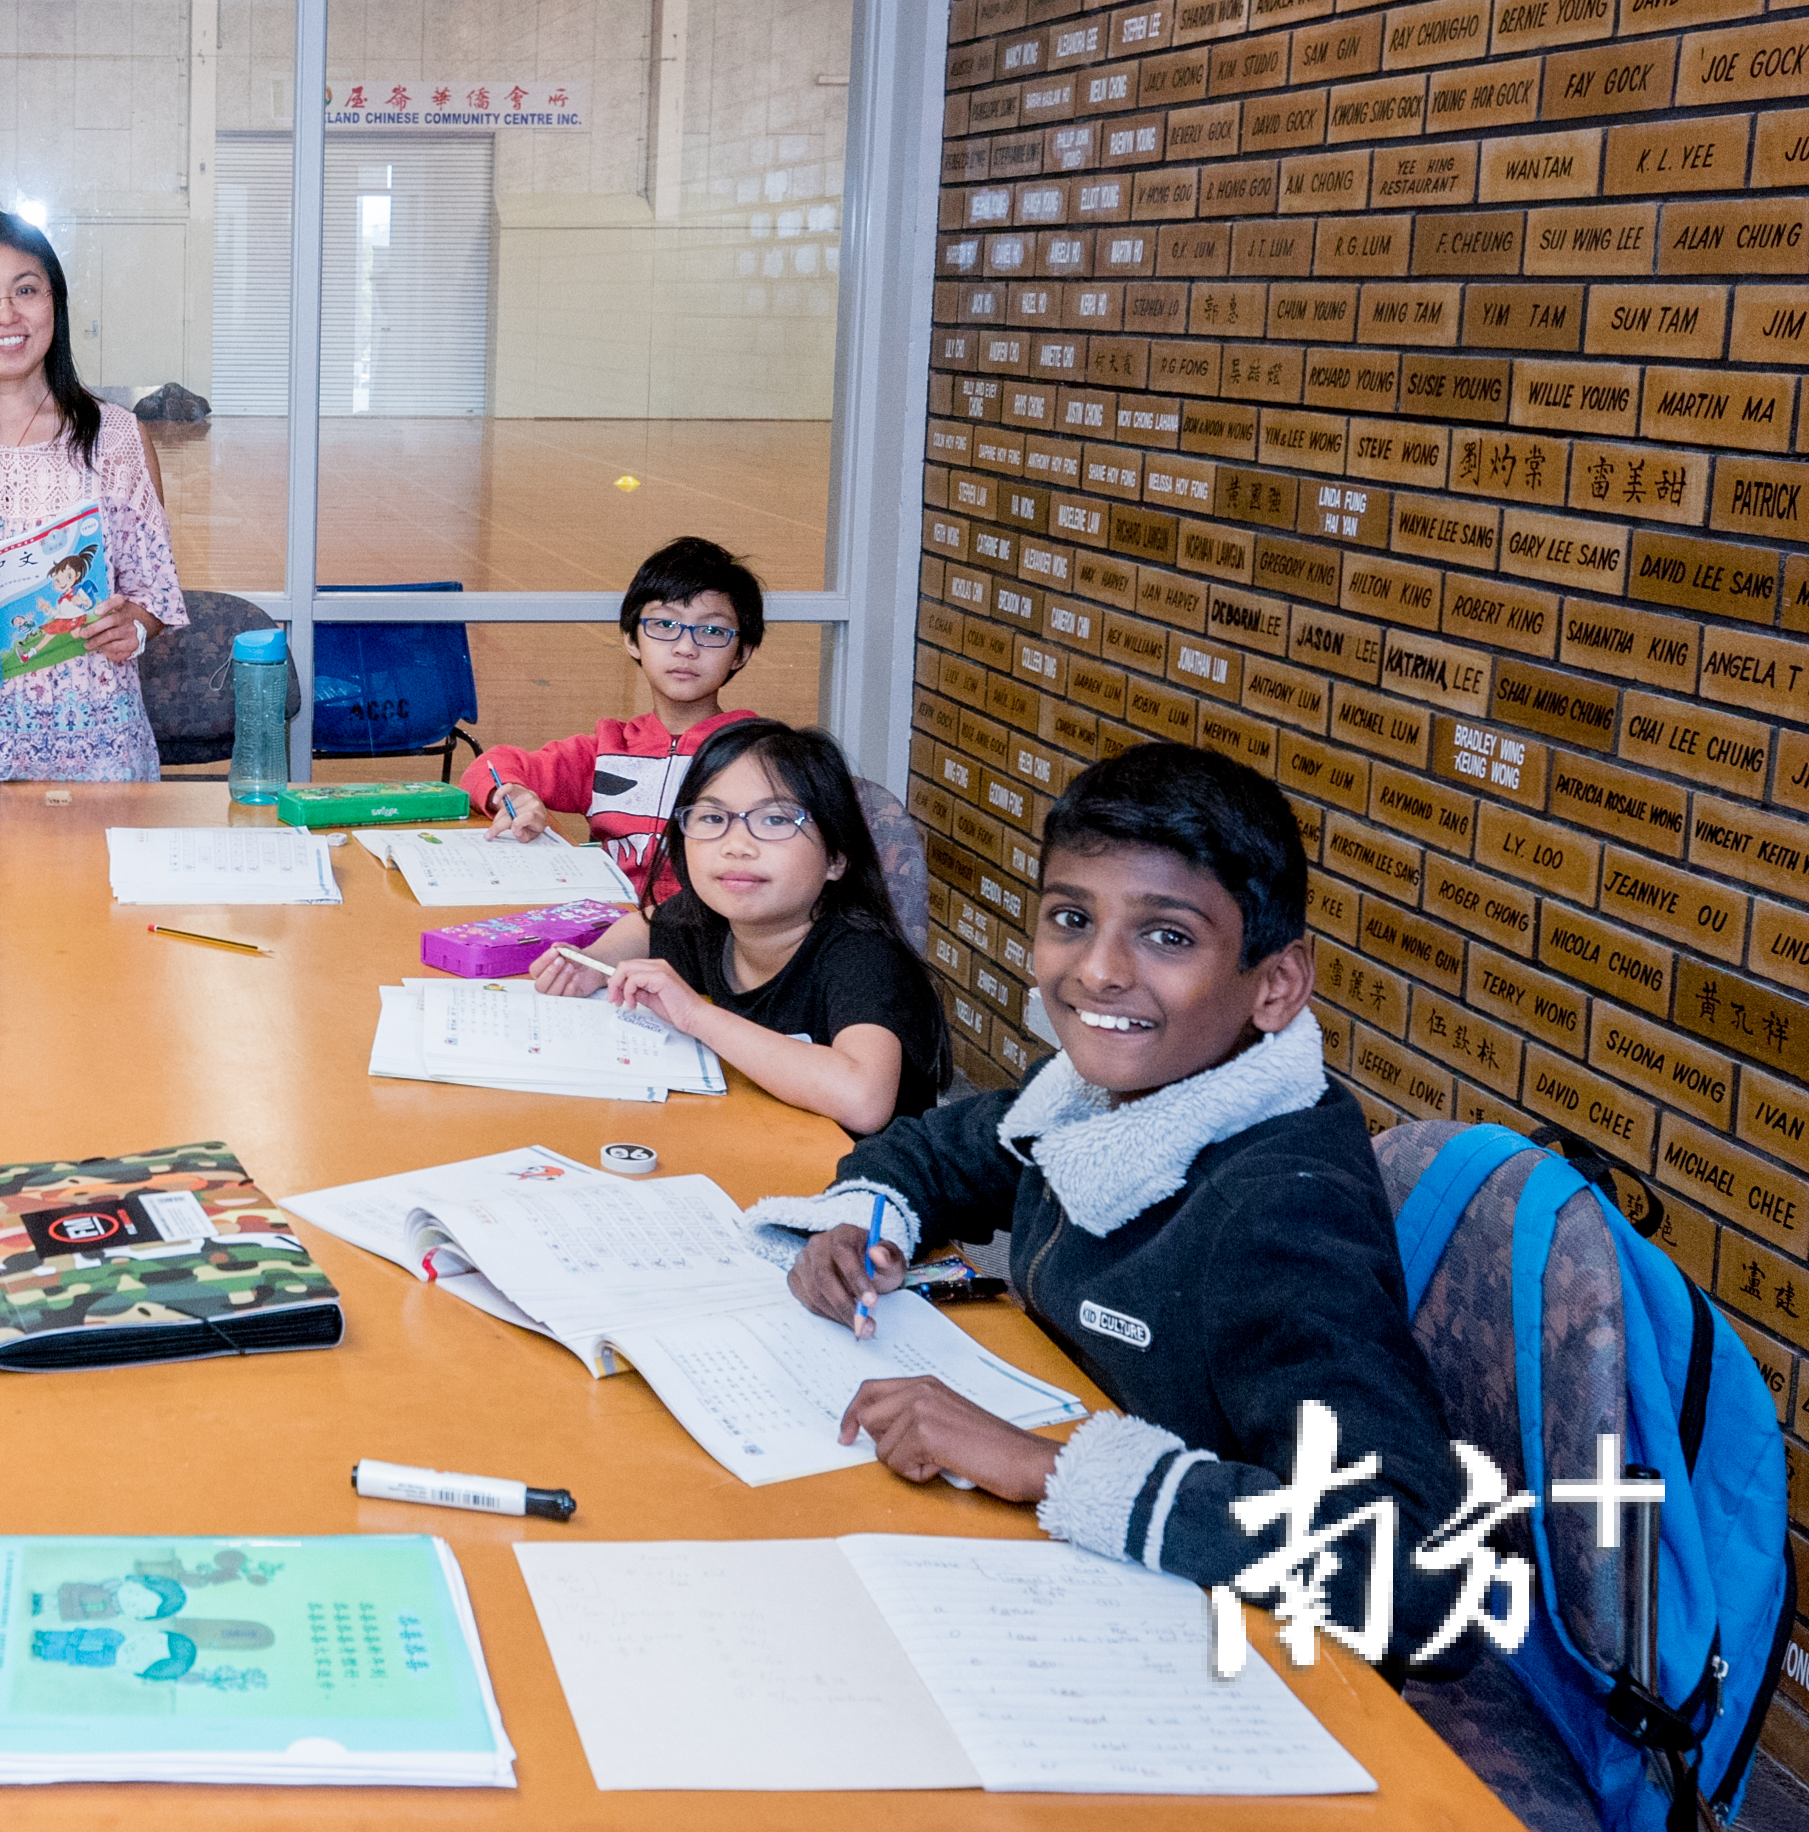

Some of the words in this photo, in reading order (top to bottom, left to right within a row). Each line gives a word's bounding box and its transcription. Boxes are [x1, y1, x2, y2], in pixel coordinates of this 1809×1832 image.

[1498, 2, 1549, 34] BERNIE
[1555, 0, 1608, 22] YOUNG
[1303, 44, 1329, 66] SAM
[1337, 37, 1360, 60] GIN
[1389, 28, 1413, 52] RAY
[1145, 71, 1167, 91] JACK
[1172, 64, 1203, 87] CHONG
[1243, 52, 1278, 76] STUDIO
[1565, 72, 1596, 99] FAY
[1604, 63, 1655, 94] GOCK
[365, 112, 419, 124] CHINESE
[424, 112, 500, 124] COMMUNITY
[504, 113, 553, 125] CENTRE
[557, 113, 582, 126] INC.
[1252, 116, 1281, 136] DAVID
[1287, 108, 1318, 132] GOCK
[1331, 102, 1368, 126] KWONG
[1370, 100, 1395, 123] SING
[1397, 94, 1424, 119] GOCK
[1208, 120, 1234, 140] GOCK
[1379, 175, 1459, 196] RESTAURANT
[1540, 229, 1567, 250] SUI
[1573, 228, 1611, 251] WING
[1617, 226, 1644, 250] LEE
[1673, 225, 1725, 250] ALAN
[1737, 222, 1802, 249] CHUNG
[1277, 300, 1307, 320] CHUM
[1313, 300, 1346, 320] YOUNG
[1373, 301, 1407, 323] MING
[1413, 302, 1444, 324] TAM
[1483, 303, 1511, 326] YIM
[1529, 304, 1567, 328] TAM
[1611, 307, 1652, 332] SUN
[1657, 307, 1699, 334] TAM
[1762, 310, 1807, 340] JIM
[1309, 366, 1351, 388] RICHARD
[1355, 369, 1395, 393] YOUNG
[1407, 373, 1445, 398] SUSIE
[1452, 376, 1502, 402] YOUNG
[1528, 381, 1574, 410] WILLIE
[1579, 385, 1630, 412] YOUNG
[1657, 391, 1729, 419] MARTIN
[1741, 397, 1775, 422] MA
[1357, 437, 1393, 460] STEVE
[1401, 442, 1439, 466] WONG
[1319, 486, 1341, 508] LINDA
[1731, 480, 1802, 520] PATRICK
[1325, 514, 1339, 532] HAI
[1343, 516, 1359, 537] YAN
[1398, 511, 1436, 540] WAYNE
[1437, 519, 1458, 542] LEE
[1459, 524, 1494, 549] SANG
[1259, 551, 1306, 578] GREGORY
[1307, 562, 1335, 586] KING
[1509, 532, 1544, 558] GARY
[1547, 538, 1574, 563] LEE
[1577, 544, 1620, 572] SANG
[1349, 572, 1392, 598] HILTON
[1399, 580, 1432, 608] KING
[1639, 555, 1687, 584] DAVID
[1693, 564, 1725, 592] LEE
[1729, 571, 1775, 599] SANG
[1451, 595, 1506, 624] ROBERT
[1507, 606, 1544, 635] KING
[1296, 622, 1345, 656] JASON
[1355, 638, 1379, 665] LEE
[1566, 620, 1635, 654] SAMANTHA
[1647, 637, 1689, 666] KING
[1385, 644, 1448, 691] KATRINA
[1453, 663, 1484, 694] LEE
[1104, 683, 1123, 702] LUM
[1248, 674, 1295, 704] ANTHONY
[1297, 690, 1322, 713] LUM
[1497, 678, 1532, 700] SHAI
[1533, 686, 1569, 717] MING
[1570, 699, 1614, 730] CHUNG
[1168, 706, 1190, 728] LUM
[1338, 702, 1386, 736] MICHAEL
[1390, 720, 1420, 746] LUM
[1203, 720, 1241, 748] MERVYN
[1247, 737, 1270, 759] LUM
[1454, 724, 1497, 756] BRADLEY
[1500, 738, 1525, 766] WING
[1629, 715, 1665, 746] CHAI
[1669, 726, 1701, 755] LEE
[1706, 736, 1765, 773] CHUNG
[1291, 754, 1324, 778] CINDY
[1330, 768, 1354, 792] LUM
[1454, 751, 1486, 779] KEUNG
[1491, 763, 1520, 790] WONG
[1380, 786, 1433, 820] RAYMOND
[1439, 807, 1469, 835] TANG
[1555, 774, 1603, 808] PATRICIA
[1649, 806, 1684, 834] WONG
[1329, 832, 1375, 869] KIRSTINA
[1375, 852, 1394, 876] LEE
[1395, 860, 1421, 887] SANG
[1694, 820, 1753, 853] VINCENT
[1757, 840, 1799, 872] KEITH
[1321, 892, 1344, 919] KEE
[1439, 879, 1480, 913] ROGER
[1485, 901, 1530, 933] CHONG
[1604, 871, 1679, 914] JEANNYE
[1698, 905, 1729, 933] OU
[1365, 918, 1398, 945] ALLAN
[1401, 933, 1431, 962] WONG
[1435, 949, 1460, 976] GUN
[1550, 927, 1601, 964] NICOLA
[1609, 951, 1663, 992] CHONG
[1483, 970, 1526, 1007] TERRY
[1534, 995, 1578, 1032] WONG
[1357, 1048, 1402, 1086] JEFFERY
[1409, 1077, 1446, 1111] LOWE
[1606, 1030, 1665, 1074] SHONA
[1672, 1062, 1726, 1104] WONG
[1536, 1073, 1579, 1110] DAVID
[1589, 1101, 1635, 1140] CHEE
[1755, 1102, 1806, 1141] IVAN
[1664, 1141, 1734, 1197] MICHAEL
[1748, 1185, 1797, 1231] CHEE
[1101, 1311, 1145, 1341] CULTURE
